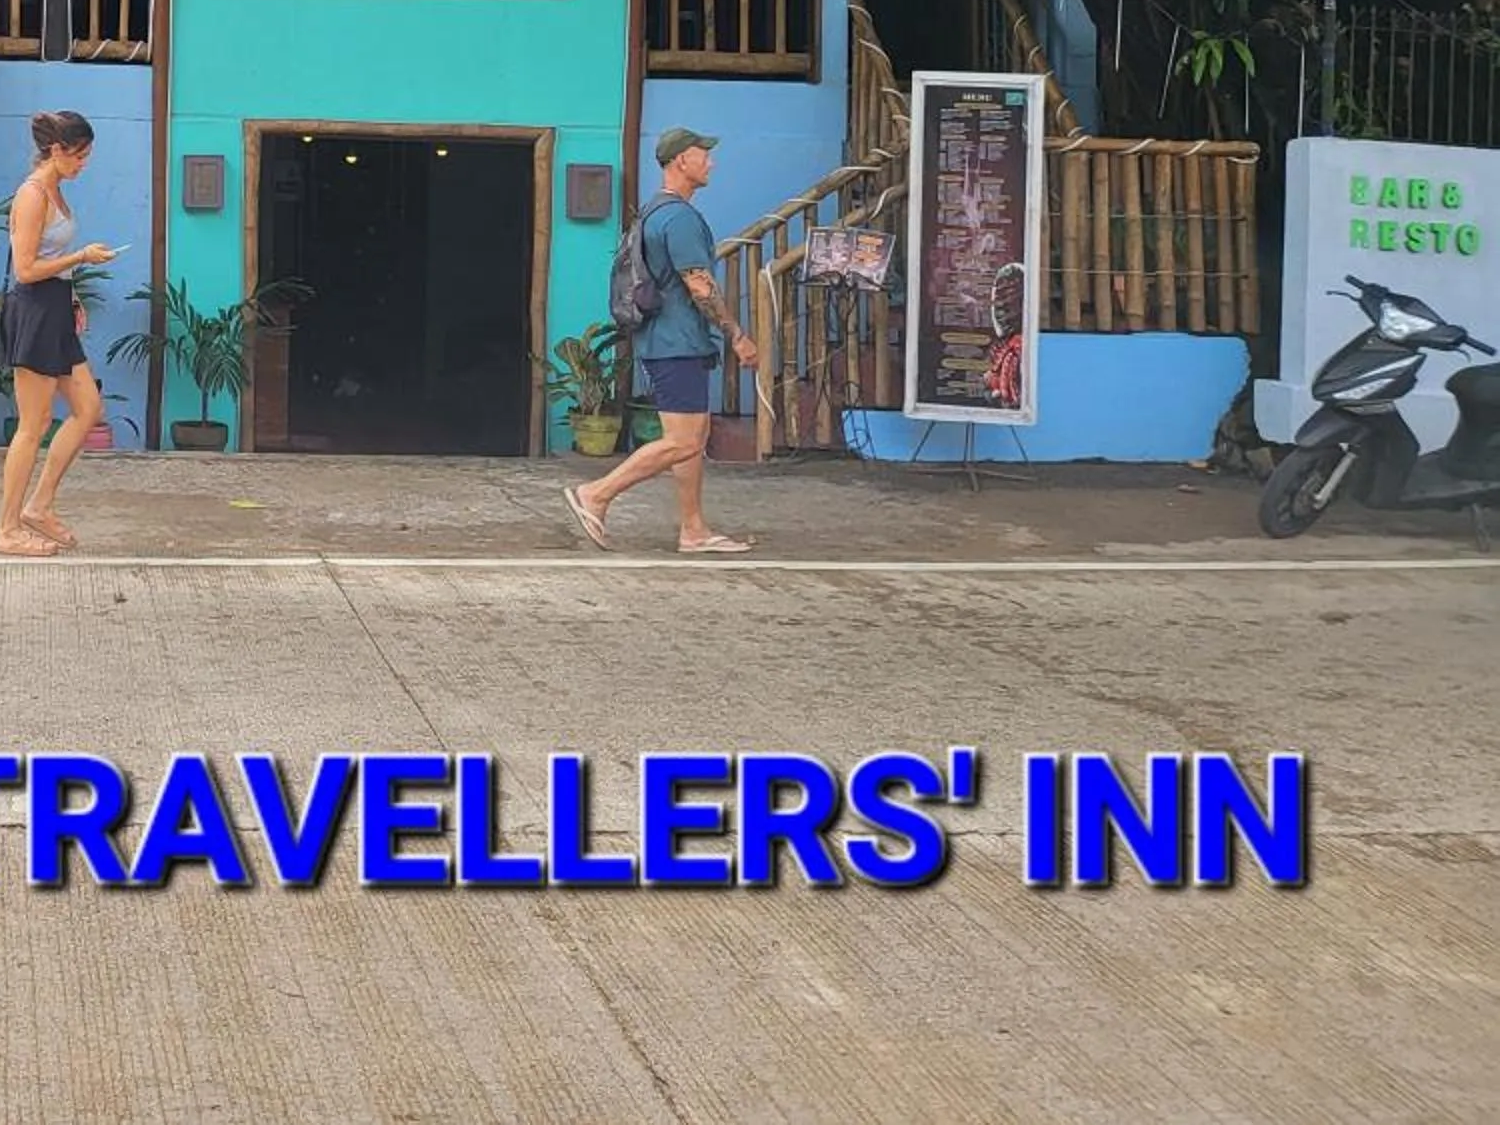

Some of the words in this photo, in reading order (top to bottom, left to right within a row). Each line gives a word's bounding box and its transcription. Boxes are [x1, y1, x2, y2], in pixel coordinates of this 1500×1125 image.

[1349, 174, 1429, 209] BAR
[1442, 182, 1461, 209] &
[1349, 219, 1480, 255] RESTO
